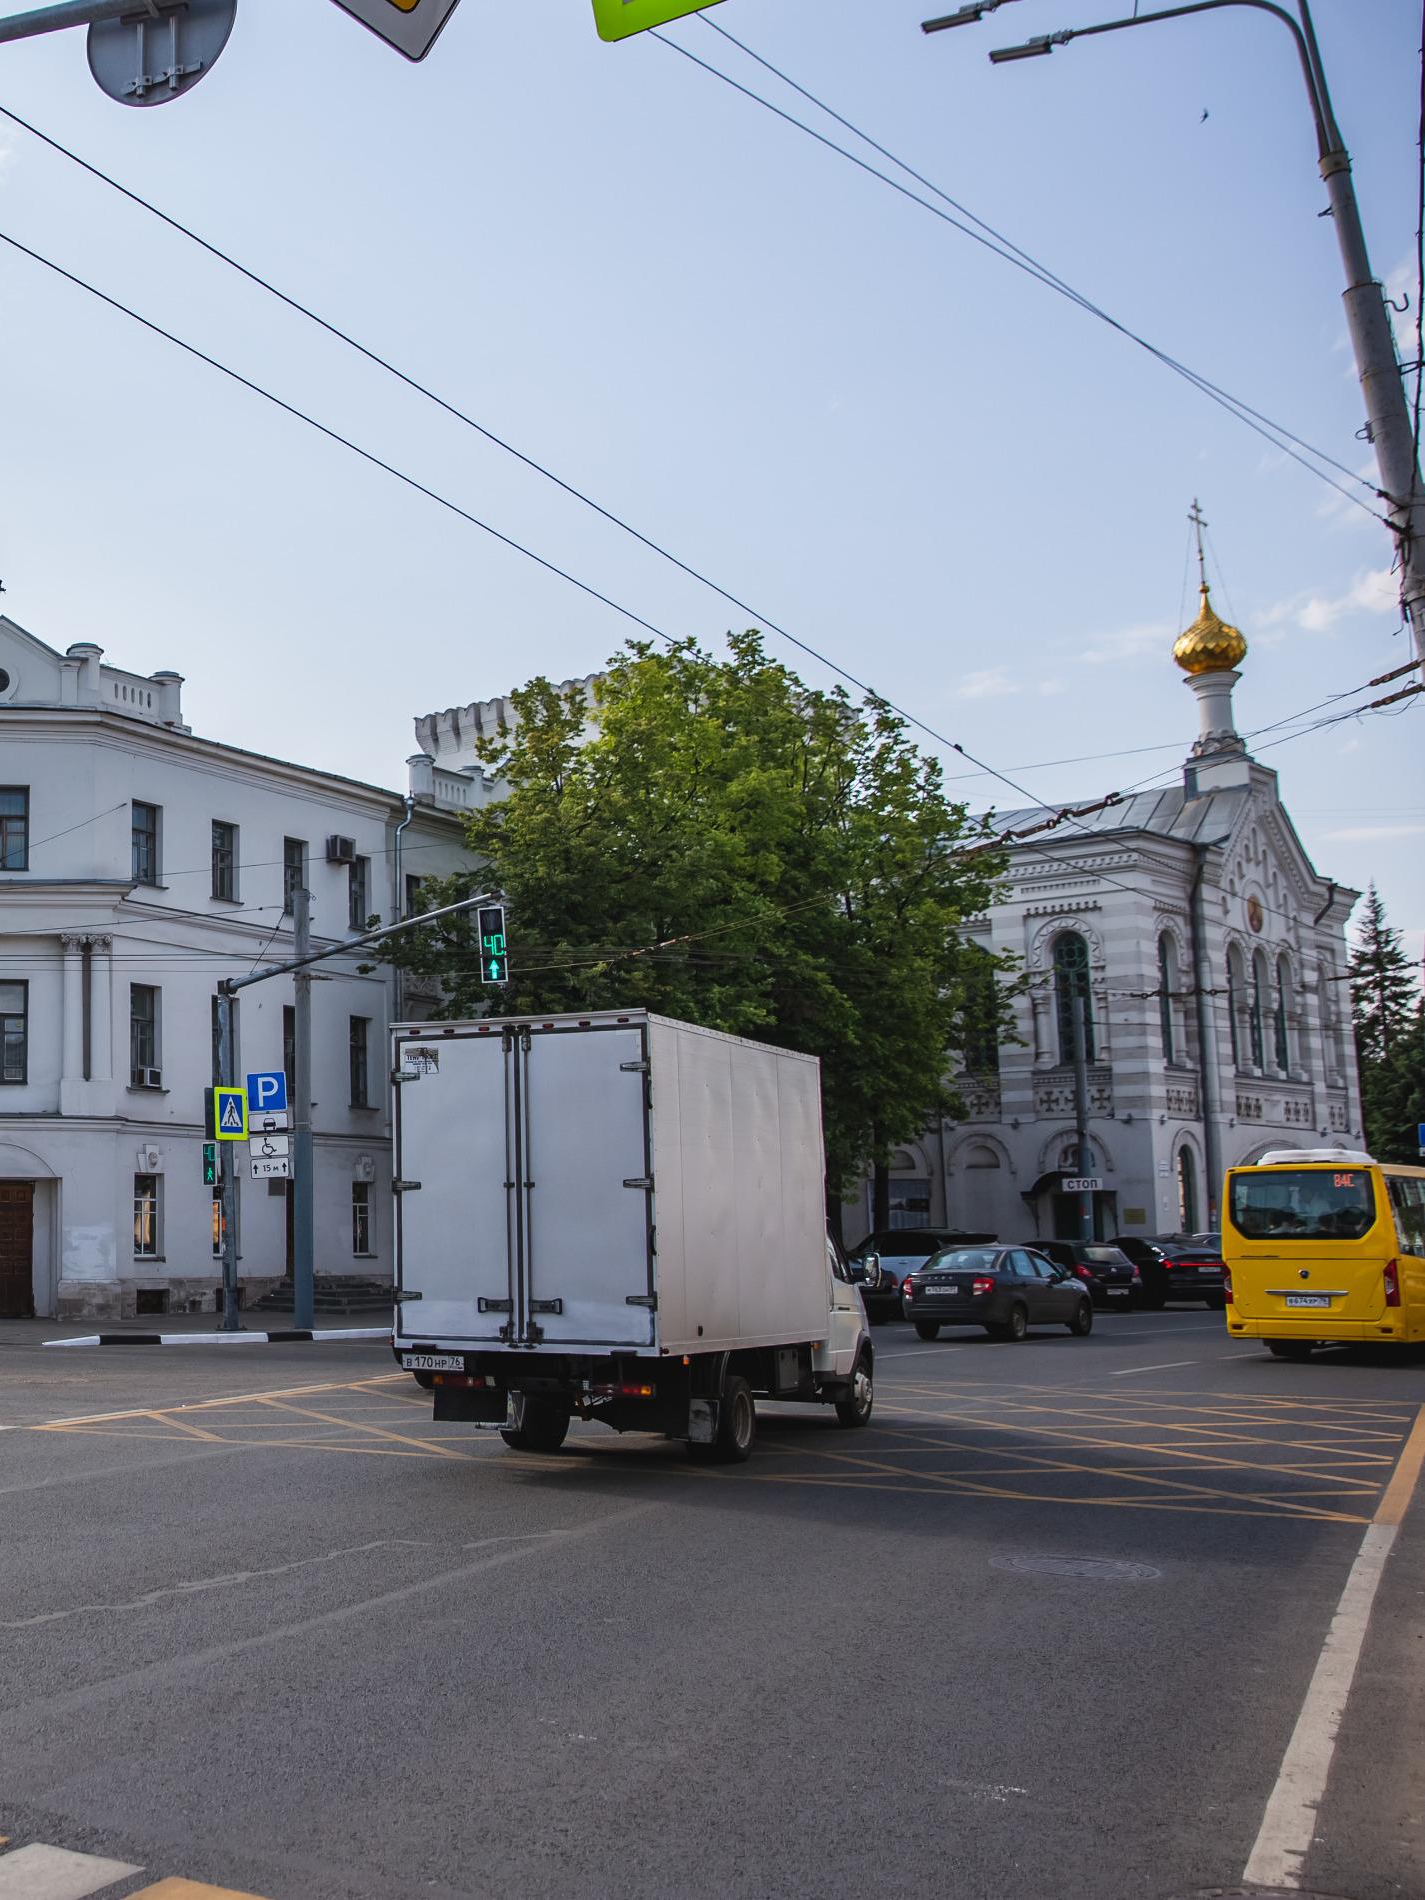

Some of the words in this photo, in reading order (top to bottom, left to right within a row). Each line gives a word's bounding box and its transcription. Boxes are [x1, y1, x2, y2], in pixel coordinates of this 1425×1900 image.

[483, 934, 505, 956] 40
[257, 1076, 280, 1107] P
[262, 1164, 272, 1172] 15
[1067, 1179, 1098, 1190] СТОП
